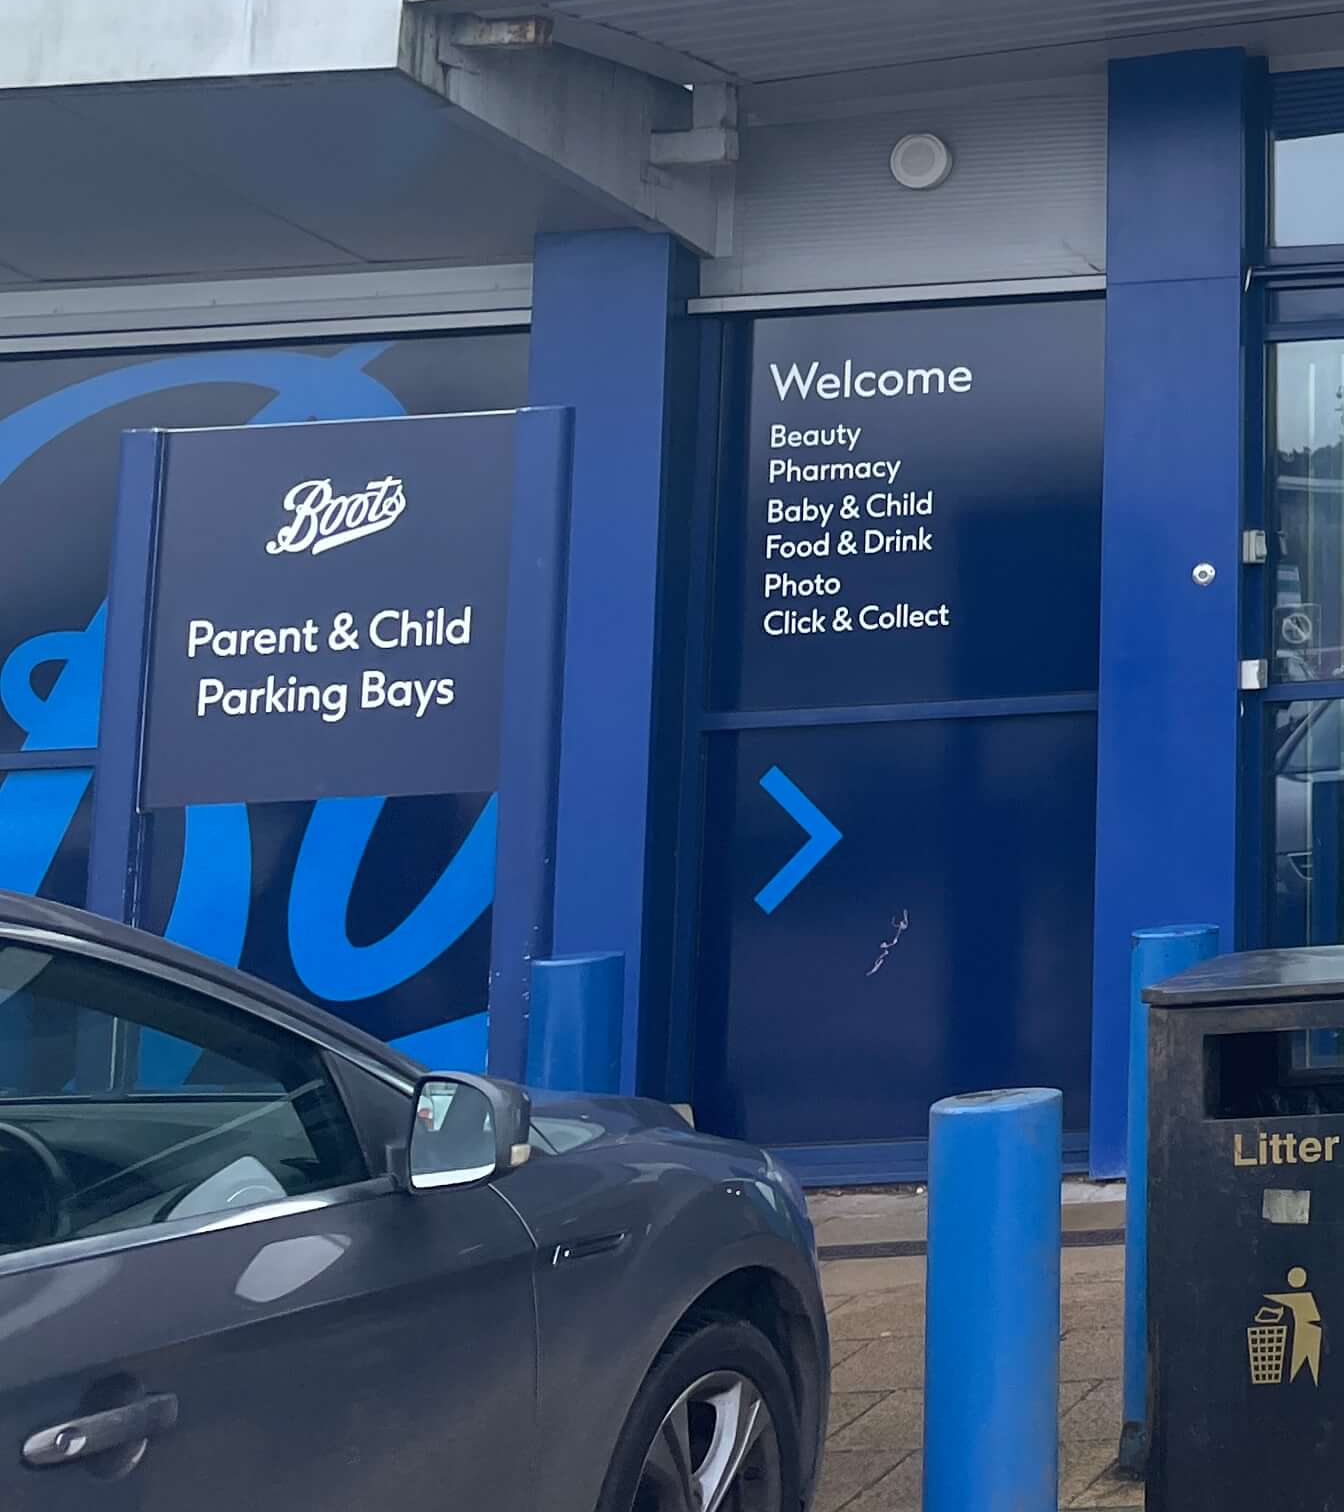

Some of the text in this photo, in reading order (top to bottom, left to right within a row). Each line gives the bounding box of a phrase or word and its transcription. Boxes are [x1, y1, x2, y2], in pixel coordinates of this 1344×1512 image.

[769, 359, 973, 401] Welcome
[769, 424, 862, 451] Beauty
[768, 457, 901, 484] Pharmacy
[265, 475, 407, 555] Boots
[767, 491, 933, 527] Baby & Child
[765, 528, 933, 559] Food & Drink
[763, 573, 841, 598] Photo
[187, 606, 472, 658] Parent & Child
[762, 603, 949, 636] Click & Collect
[197, 669, 455, 722] Parking Bays
[1234, 1132, 1340, 1166] Litter
